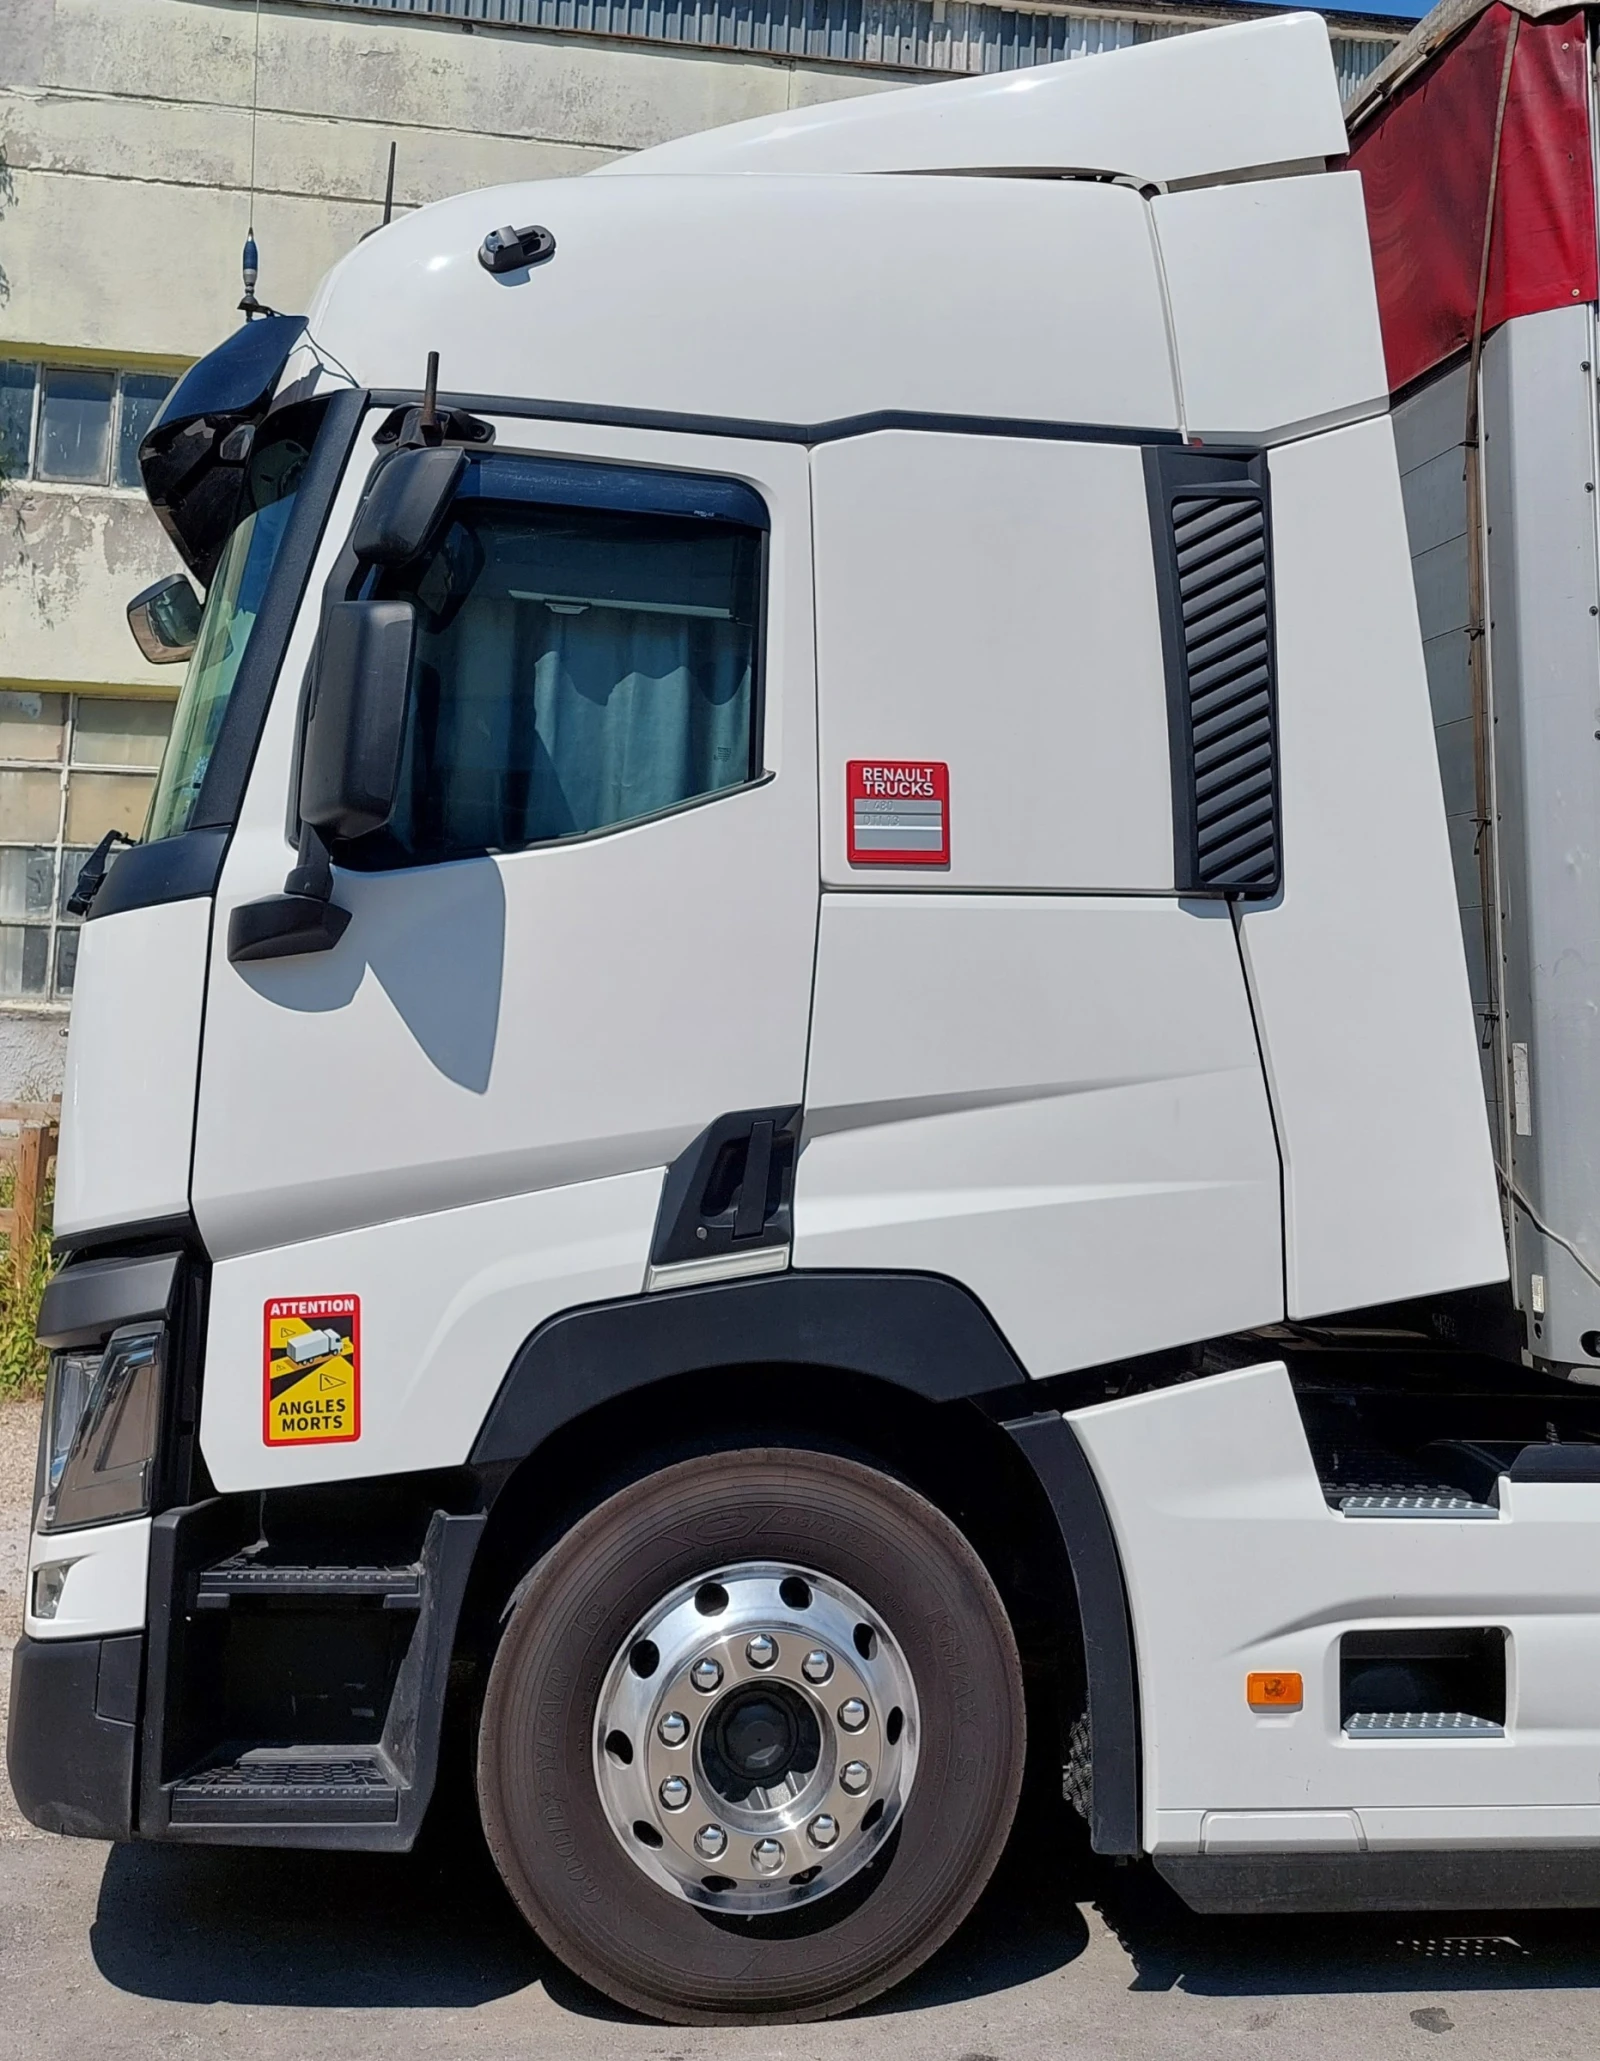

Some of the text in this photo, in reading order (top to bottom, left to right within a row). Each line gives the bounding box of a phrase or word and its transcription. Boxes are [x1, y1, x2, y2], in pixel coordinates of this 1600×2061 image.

[862, 767, 934, 782] RENAULT
[863, 781, 934, 796] TRUCKS
[270, 1299, 355, 1316] ATTENTION
[278, 1398, 346, 1416] ANGLES
[282, 1415, 343, 1432] MORTS
